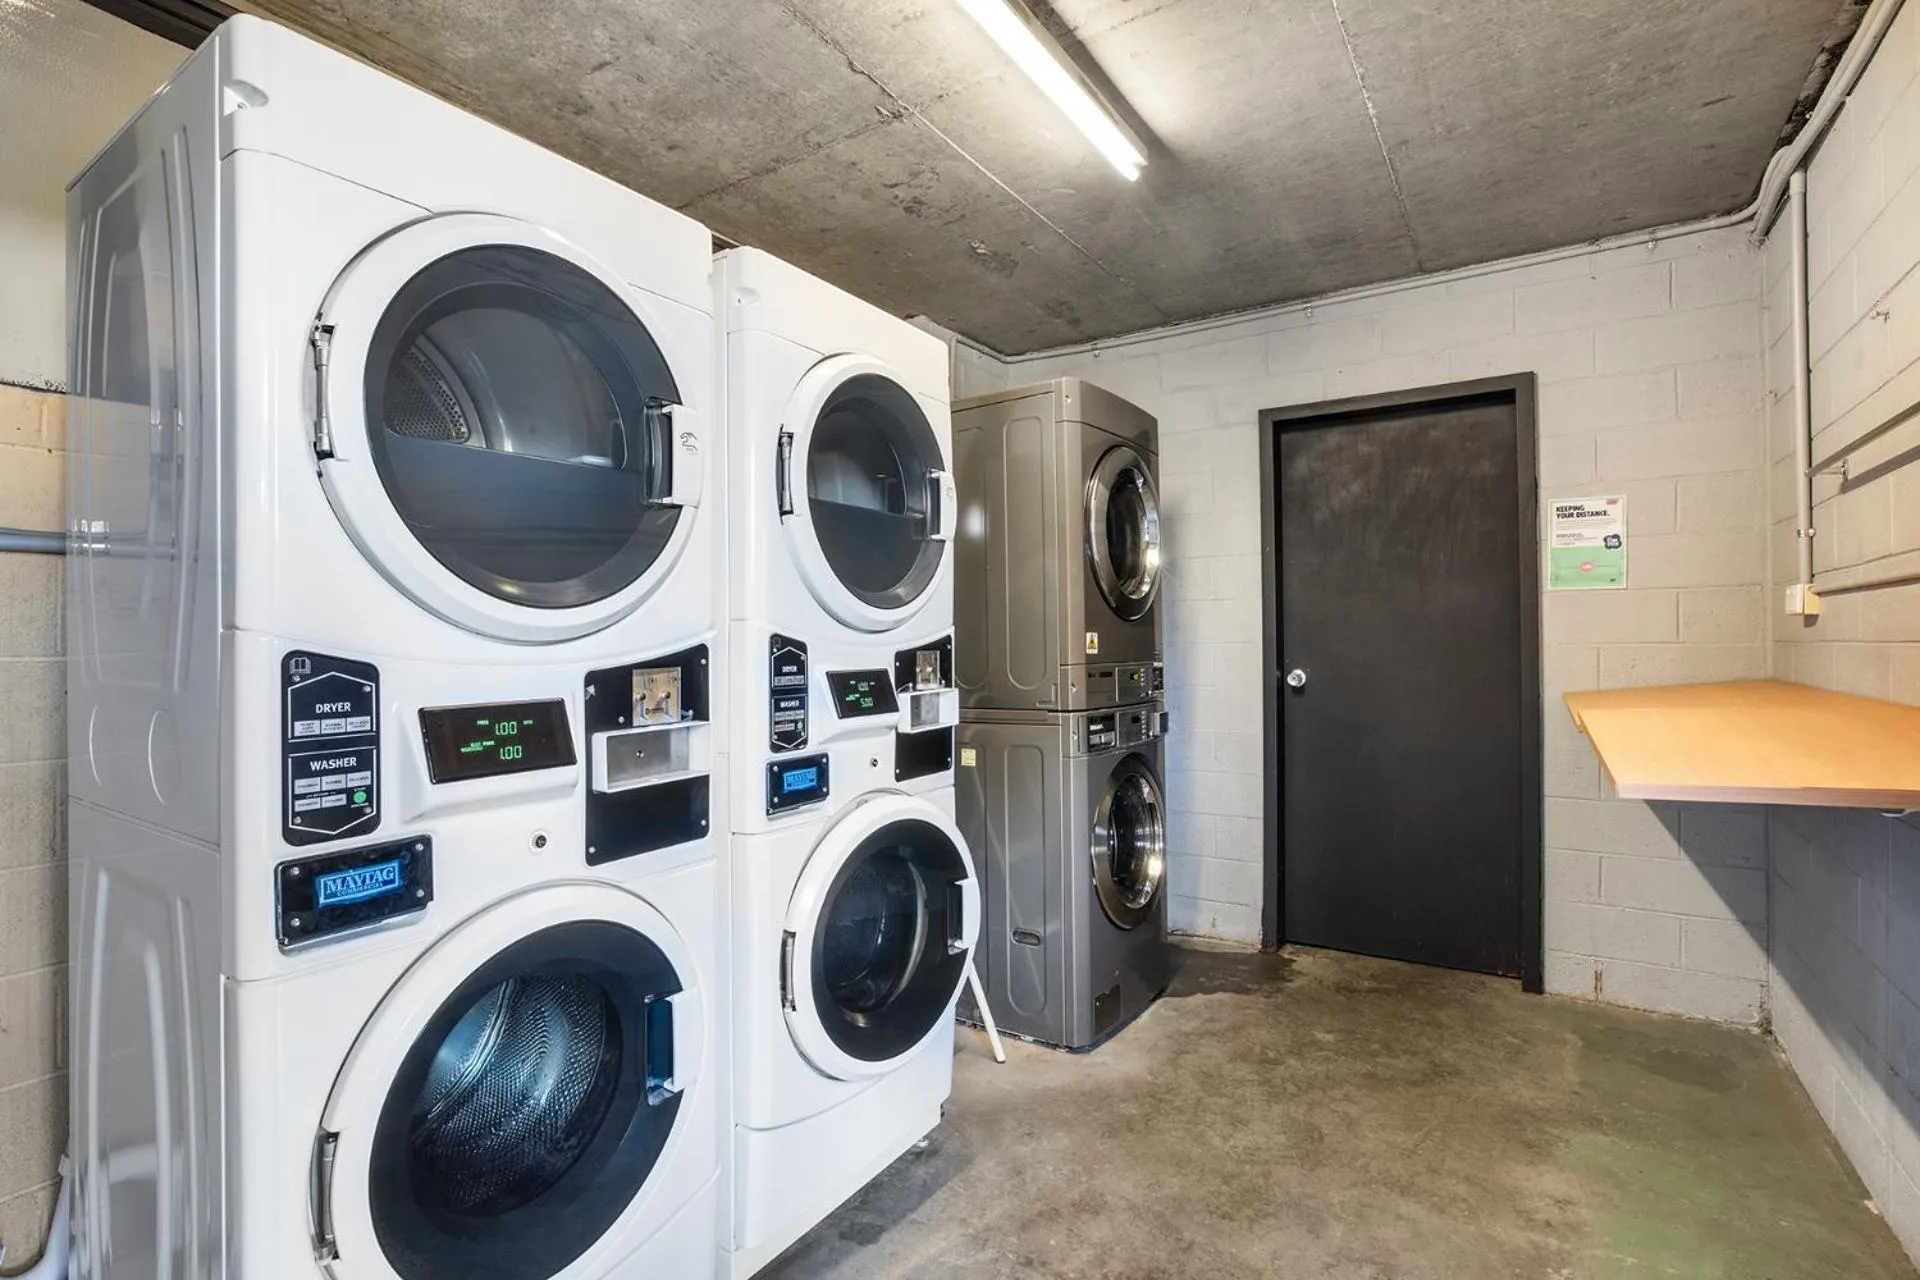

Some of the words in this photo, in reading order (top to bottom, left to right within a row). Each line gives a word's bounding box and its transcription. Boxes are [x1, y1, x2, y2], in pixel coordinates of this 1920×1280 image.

[1556, 504, 1585, 513] KEEPING
[315, 702, 352, 714] DRYER
[310, 757, 357, 772] WASHER
[326, 867, 395, 895] MAYTAG
